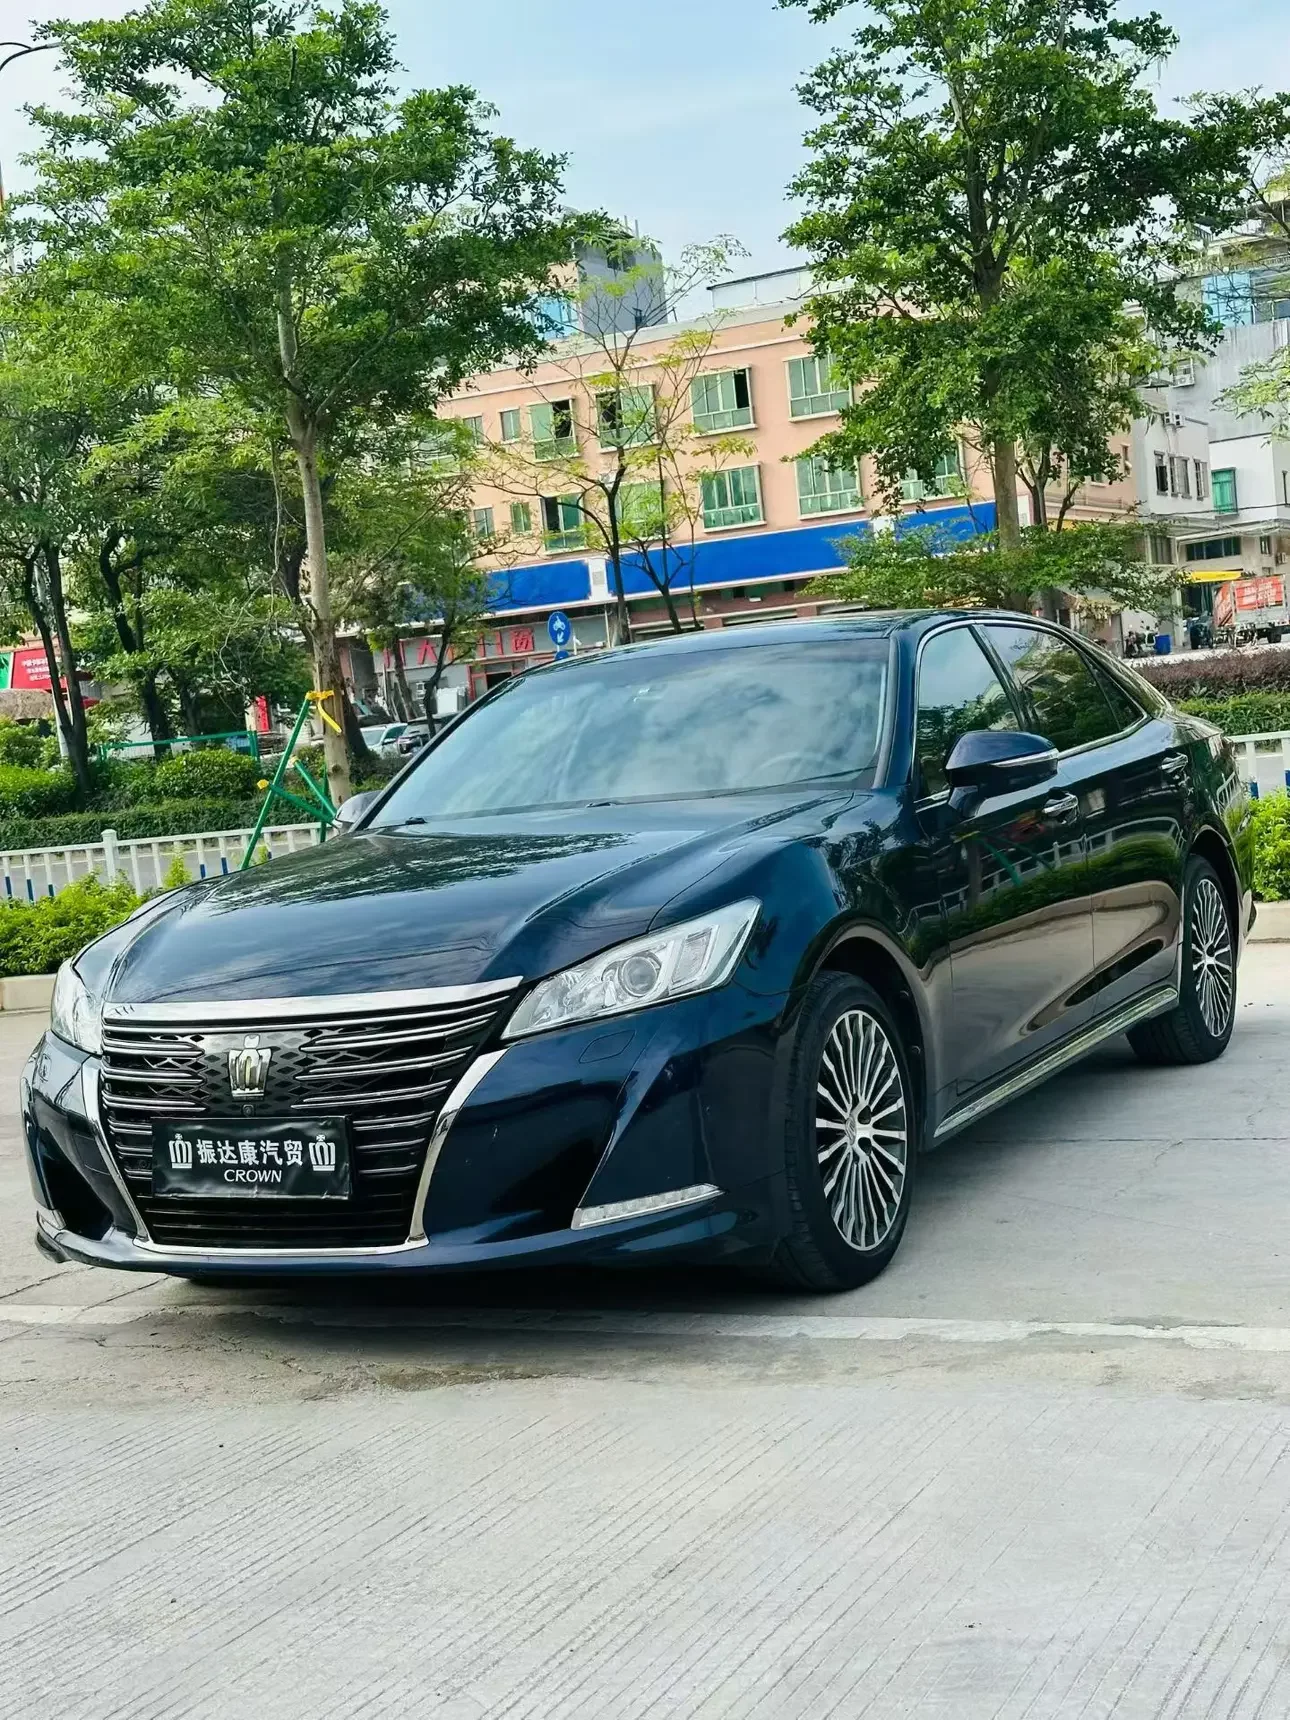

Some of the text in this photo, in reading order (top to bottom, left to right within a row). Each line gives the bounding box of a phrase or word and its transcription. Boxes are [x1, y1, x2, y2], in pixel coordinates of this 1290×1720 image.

[196, 1138, 303, 1166] 振达康汽贸
[224, 1169, 282, 1183] CROWN
